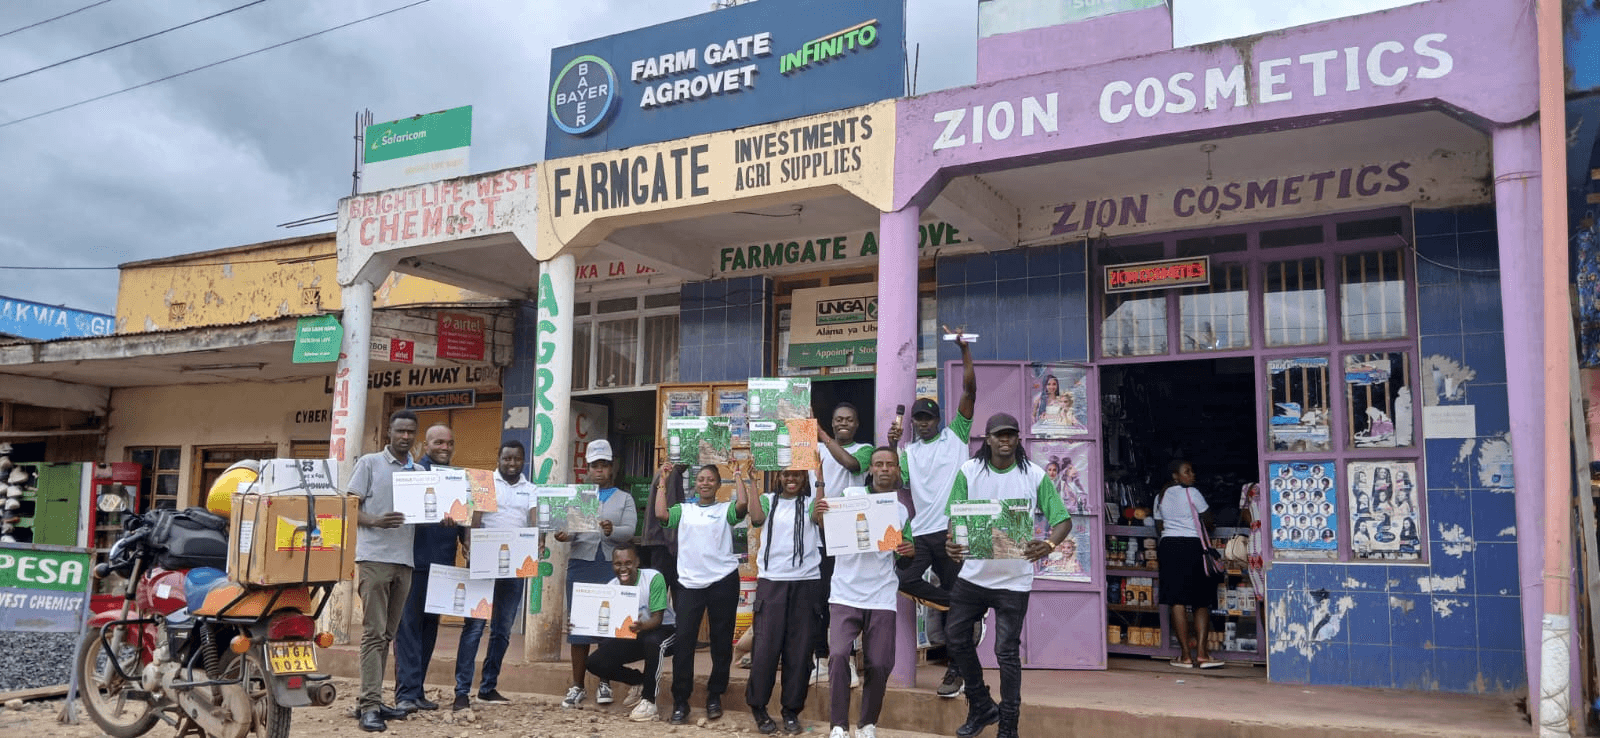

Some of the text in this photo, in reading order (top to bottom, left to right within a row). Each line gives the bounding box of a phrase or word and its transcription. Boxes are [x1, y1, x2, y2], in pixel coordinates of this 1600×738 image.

[630, 31, 772, 82] FARM GATE
[779, 24, 878, 75] INFINITO
[556, 84, 608, 107] BAYER
[576, 63, 588, 127] BAYER
[639, 64, 758, 108] AGROVET
[932, 32, 1454, 152] ZION COSMETICS
[381, 129, 427, 146] Safaricom
[734, 114, 873, 165] INVESTMENTS
[553, 143, 710, 217] FARMGATE
[734, 146, 862, 191] AGRI SUPPLIES
[476, 167, 536, 198] WEST
[1050, 161, 1412, 236] ZION COSMETICS
[360, 195, 501, 246] CHEMIST
[719, 236, 848, 272] FARMGATE
[609, 261, 626, 276] LA
[818, 299, 865, 314] UNGA
[454, 319, 481, 332] airtel
[816, 327, 844, 336] Alama
[847, 327, 858, 336] ya
[816, 346, 855, 359] Appointed
[408, 366, 461, 386] H/WAY
[410, 392, 471, 407] LODGING
[295, 409, 328, 423] CYBER
[29, 594, 83, 611] CHEMIST
[274, 660, 313, 670] 102L
